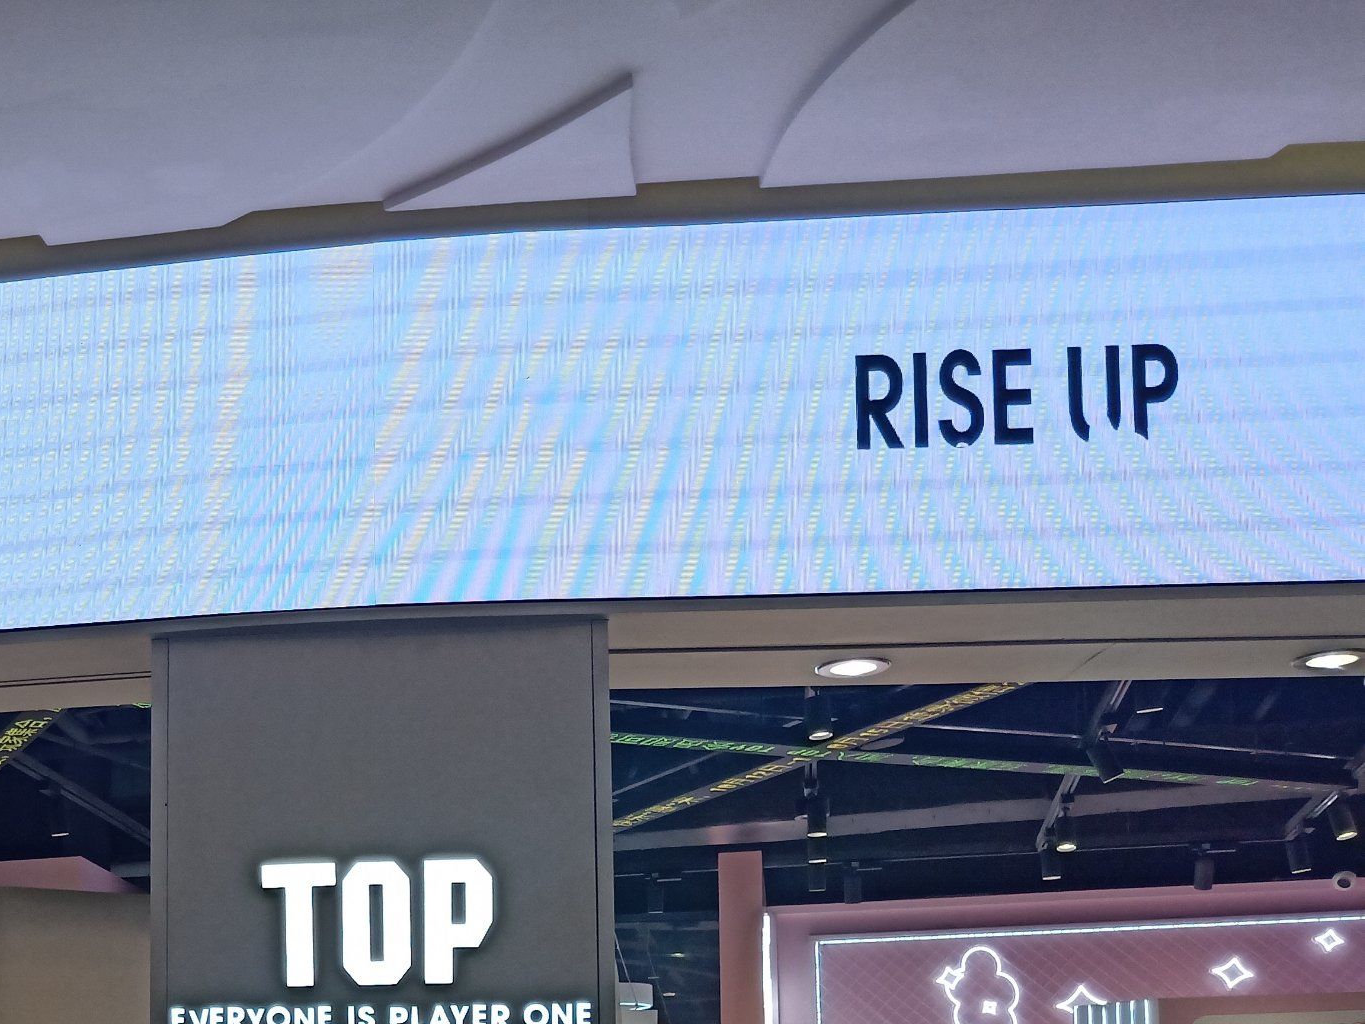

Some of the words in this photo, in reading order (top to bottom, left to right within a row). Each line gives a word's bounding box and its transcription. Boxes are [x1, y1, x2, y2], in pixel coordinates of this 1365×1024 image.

[855, 349, 1034, 450] RISE
[1067, 343, 1179, 442] UP
[260, 858, 494, 988] TOP
